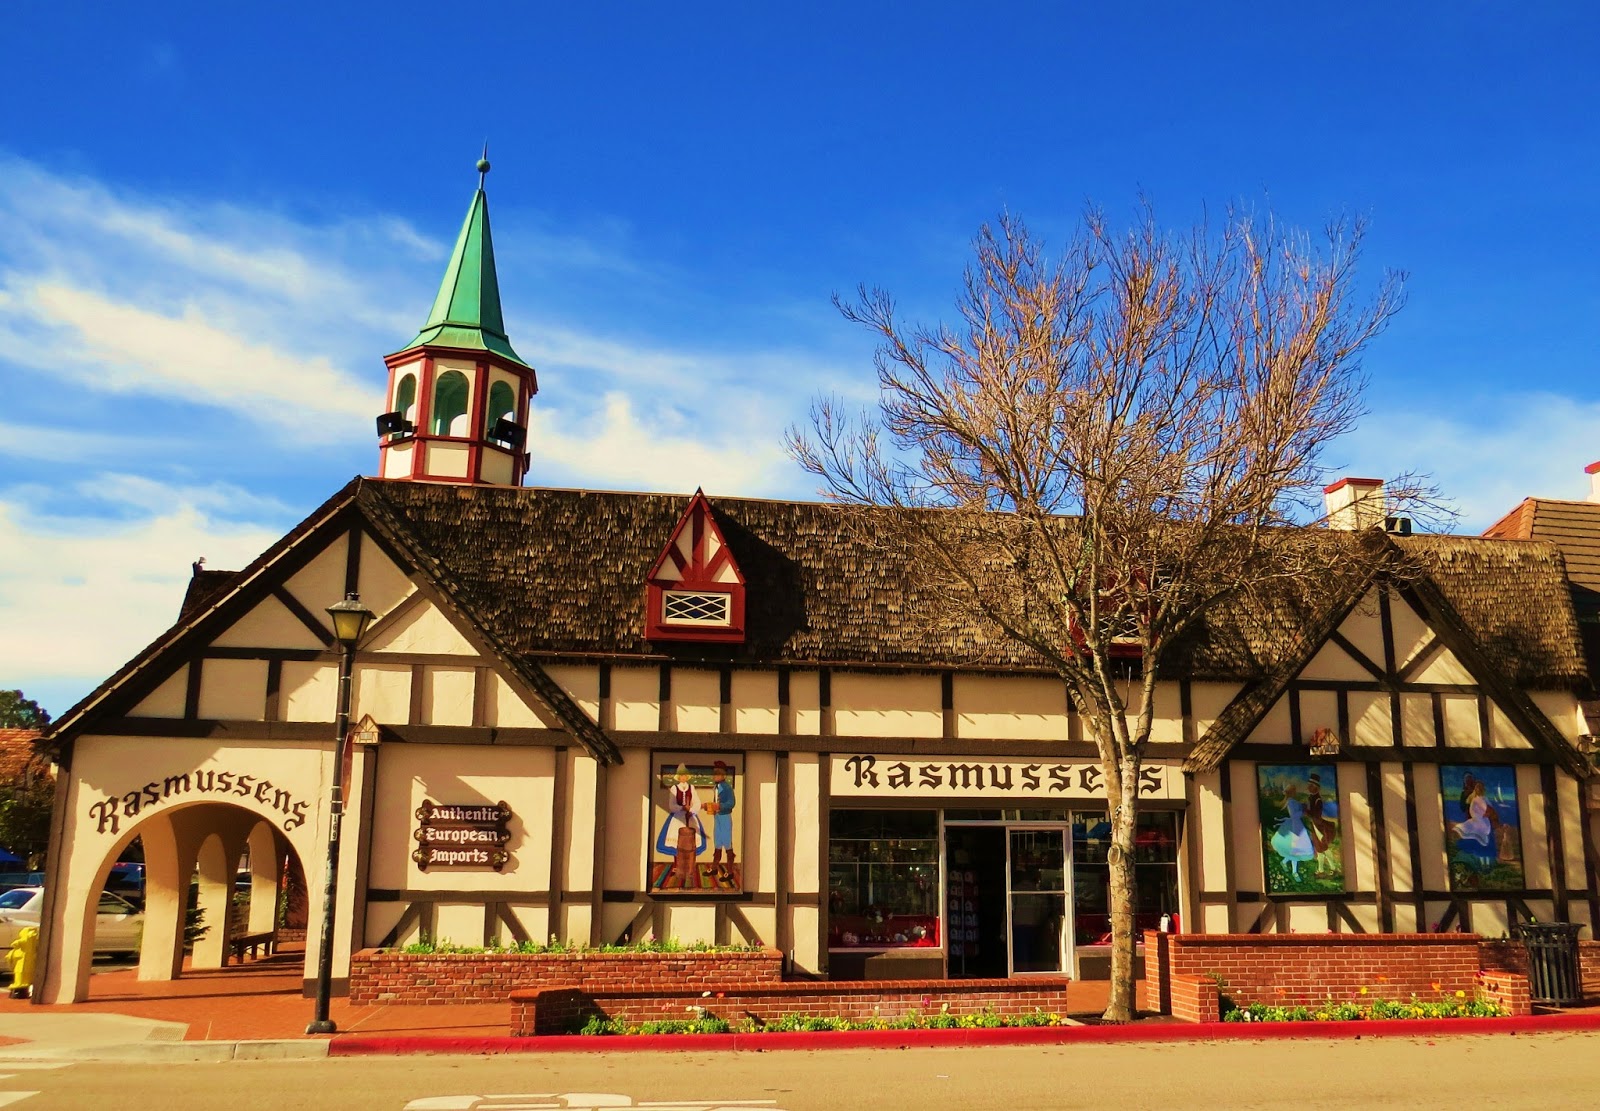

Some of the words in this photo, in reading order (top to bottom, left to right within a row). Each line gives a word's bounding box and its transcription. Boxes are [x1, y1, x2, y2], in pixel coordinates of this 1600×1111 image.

[844, 755, 1162, 795] Rasmusses
[89, 769, 310, 835] Rasmussens
[429, 808, 500, 822] Authentic
[426, 828, 498, 844] European
[429, 848, 488, 864] Imports
